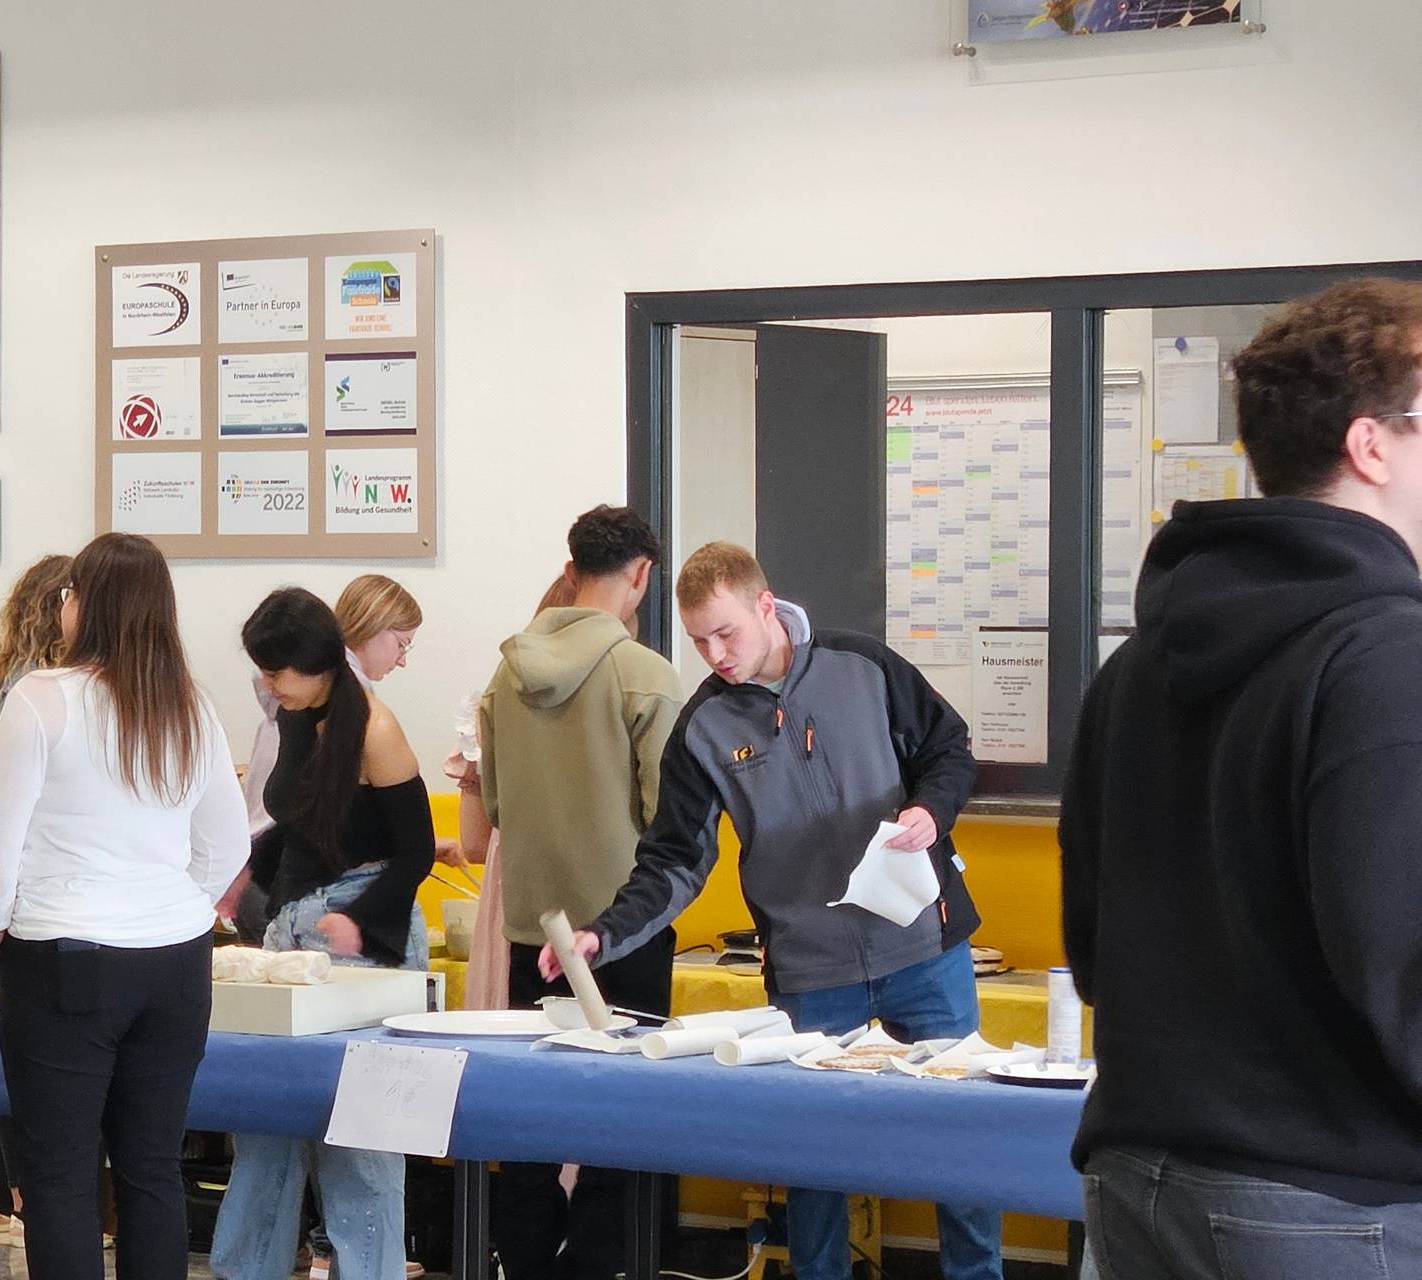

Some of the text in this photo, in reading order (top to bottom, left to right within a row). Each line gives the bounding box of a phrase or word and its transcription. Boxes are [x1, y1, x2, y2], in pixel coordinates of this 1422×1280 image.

[122, 301, 175, 310] EUROPASCHULE
[226, 299, 301, 312] Partner in Europa
[887, 394, 914, 417] 24
[263, 493, 305, 511] 2022
[335, 506, 360, 515] Bildung
[375, 506, 413, 514] Gesundheit
[982, 656, 1044, 667] Hausmeister
